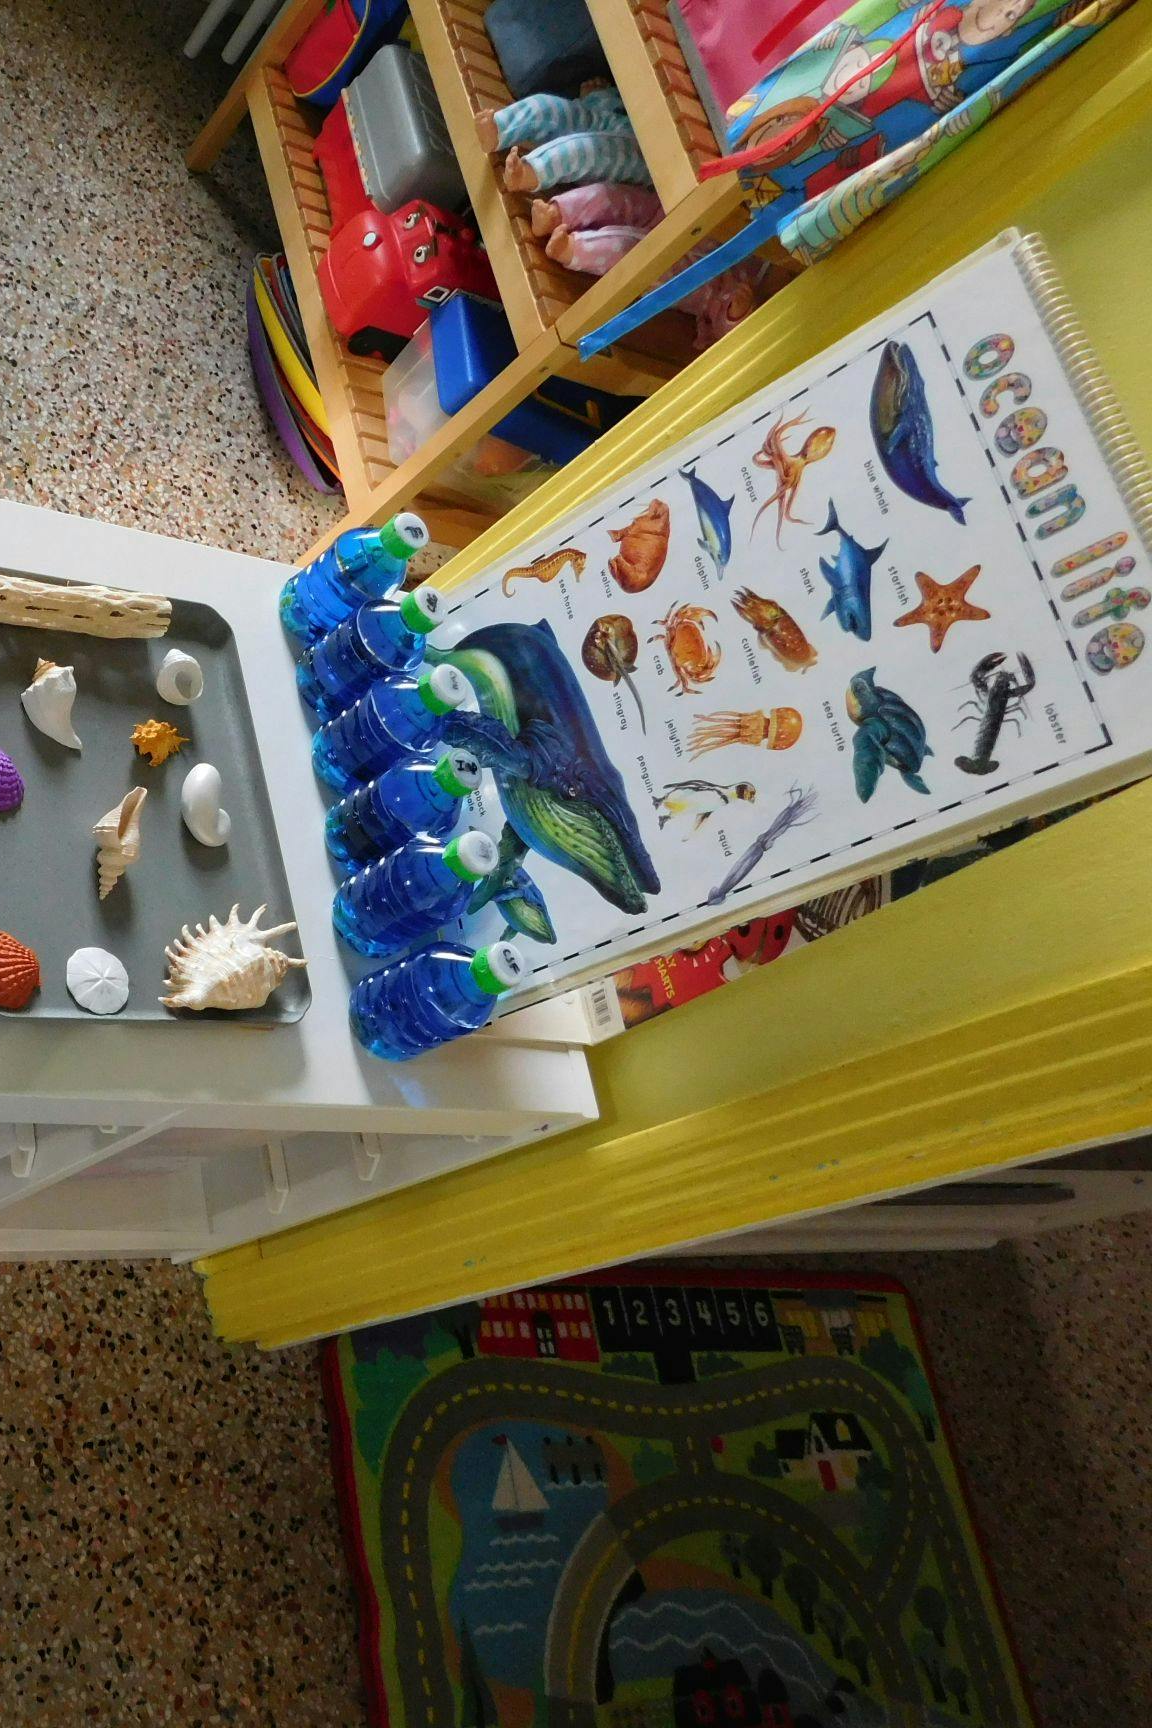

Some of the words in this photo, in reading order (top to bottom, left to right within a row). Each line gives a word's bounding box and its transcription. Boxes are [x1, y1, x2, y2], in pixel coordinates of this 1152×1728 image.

[740, 466, 758, 503] octopus
[863, 460, 876, 486] blue
[874, 484, 889, 516] whale
[962, 332, 1087, 541] ocean
[1050, 531, 1152, 675] life
[600, 569, 613, 599] walrus
[694, 556, 710, 591] dolphin
[799, 568, 816, 596] shark
[888, 566, 908, 606] starfish
[563, 594, 574, 620] horse
[653, 655, 664, 676] crab
[741, 638, 762, 685] cuttlefish
[612, 692, 629, 731] stingray
[1044, 702, 1067, 744] lobster
[664, 719, 684, 758] jellyfish
[829, 720, 845, 752] turtle
[636, 754, 654, 794] penguin
[474, 787, 488, 817] pback
[718, 829, 733, 857] squid
[655, 957, 676, 1000] HARTS
[602, 1300, 615, 1326] 1
[632, 1300, 649, 1325] 2
[665, 1298, 681, 1326] 3
[696, 1300, 712, 1326] 4
[725, 1301, 741, 1326] 5
[754, 1301, 769, 1326] 6
